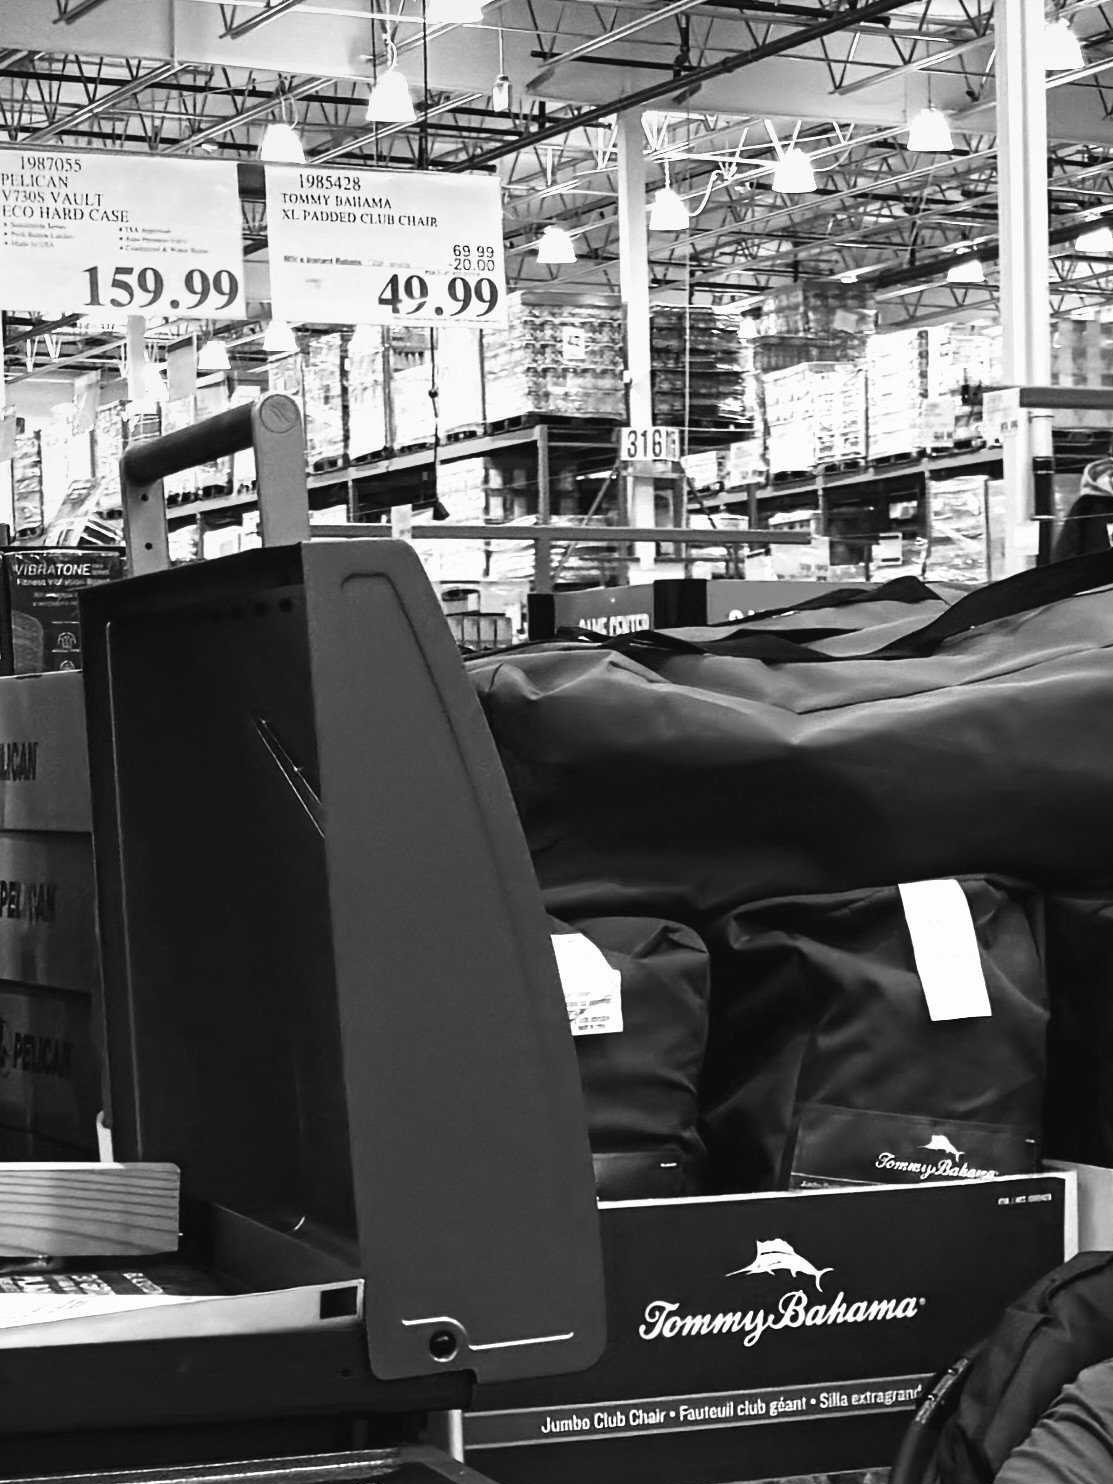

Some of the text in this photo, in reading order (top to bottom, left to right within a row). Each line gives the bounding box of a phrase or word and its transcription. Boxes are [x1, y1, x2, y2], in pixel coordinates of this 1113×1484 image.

[21, 156, 82, 172] 1987055
[1, 173, 68, 188] PELICAN
[300, 174, 361, 190] 1985428
[51, 192, 103, 206] VAULT
[281, 193, 391, 209] TOMMY BAHAMA
[2, 205, 129, 222] ECO HARD CASE
[282, 209, 437, 227] XL PADDED CLUB CHAIR
[82, 265, 239, 311] 159.99
[378, 274, 499, 317] 49.99
[627, 429, 662, 458] 316
[15, 563, 91, 576] VIBRATONE
[875, 1152, 935, 1180] Tommy
[638, 1290, 919, 1347] Tommy Bahama
[541, 1417, 590, 1434] Jumbo
[593, 1412, 626, 1430] Club
[629, 1410, 665, 1427] Chair
[679, 1402, 735, 1421] Fauteuil
[737, 1399, 766, 1417] club
[769, 1397, 807, 1416] géant
[819, 1392, 849, 1409] Silla
